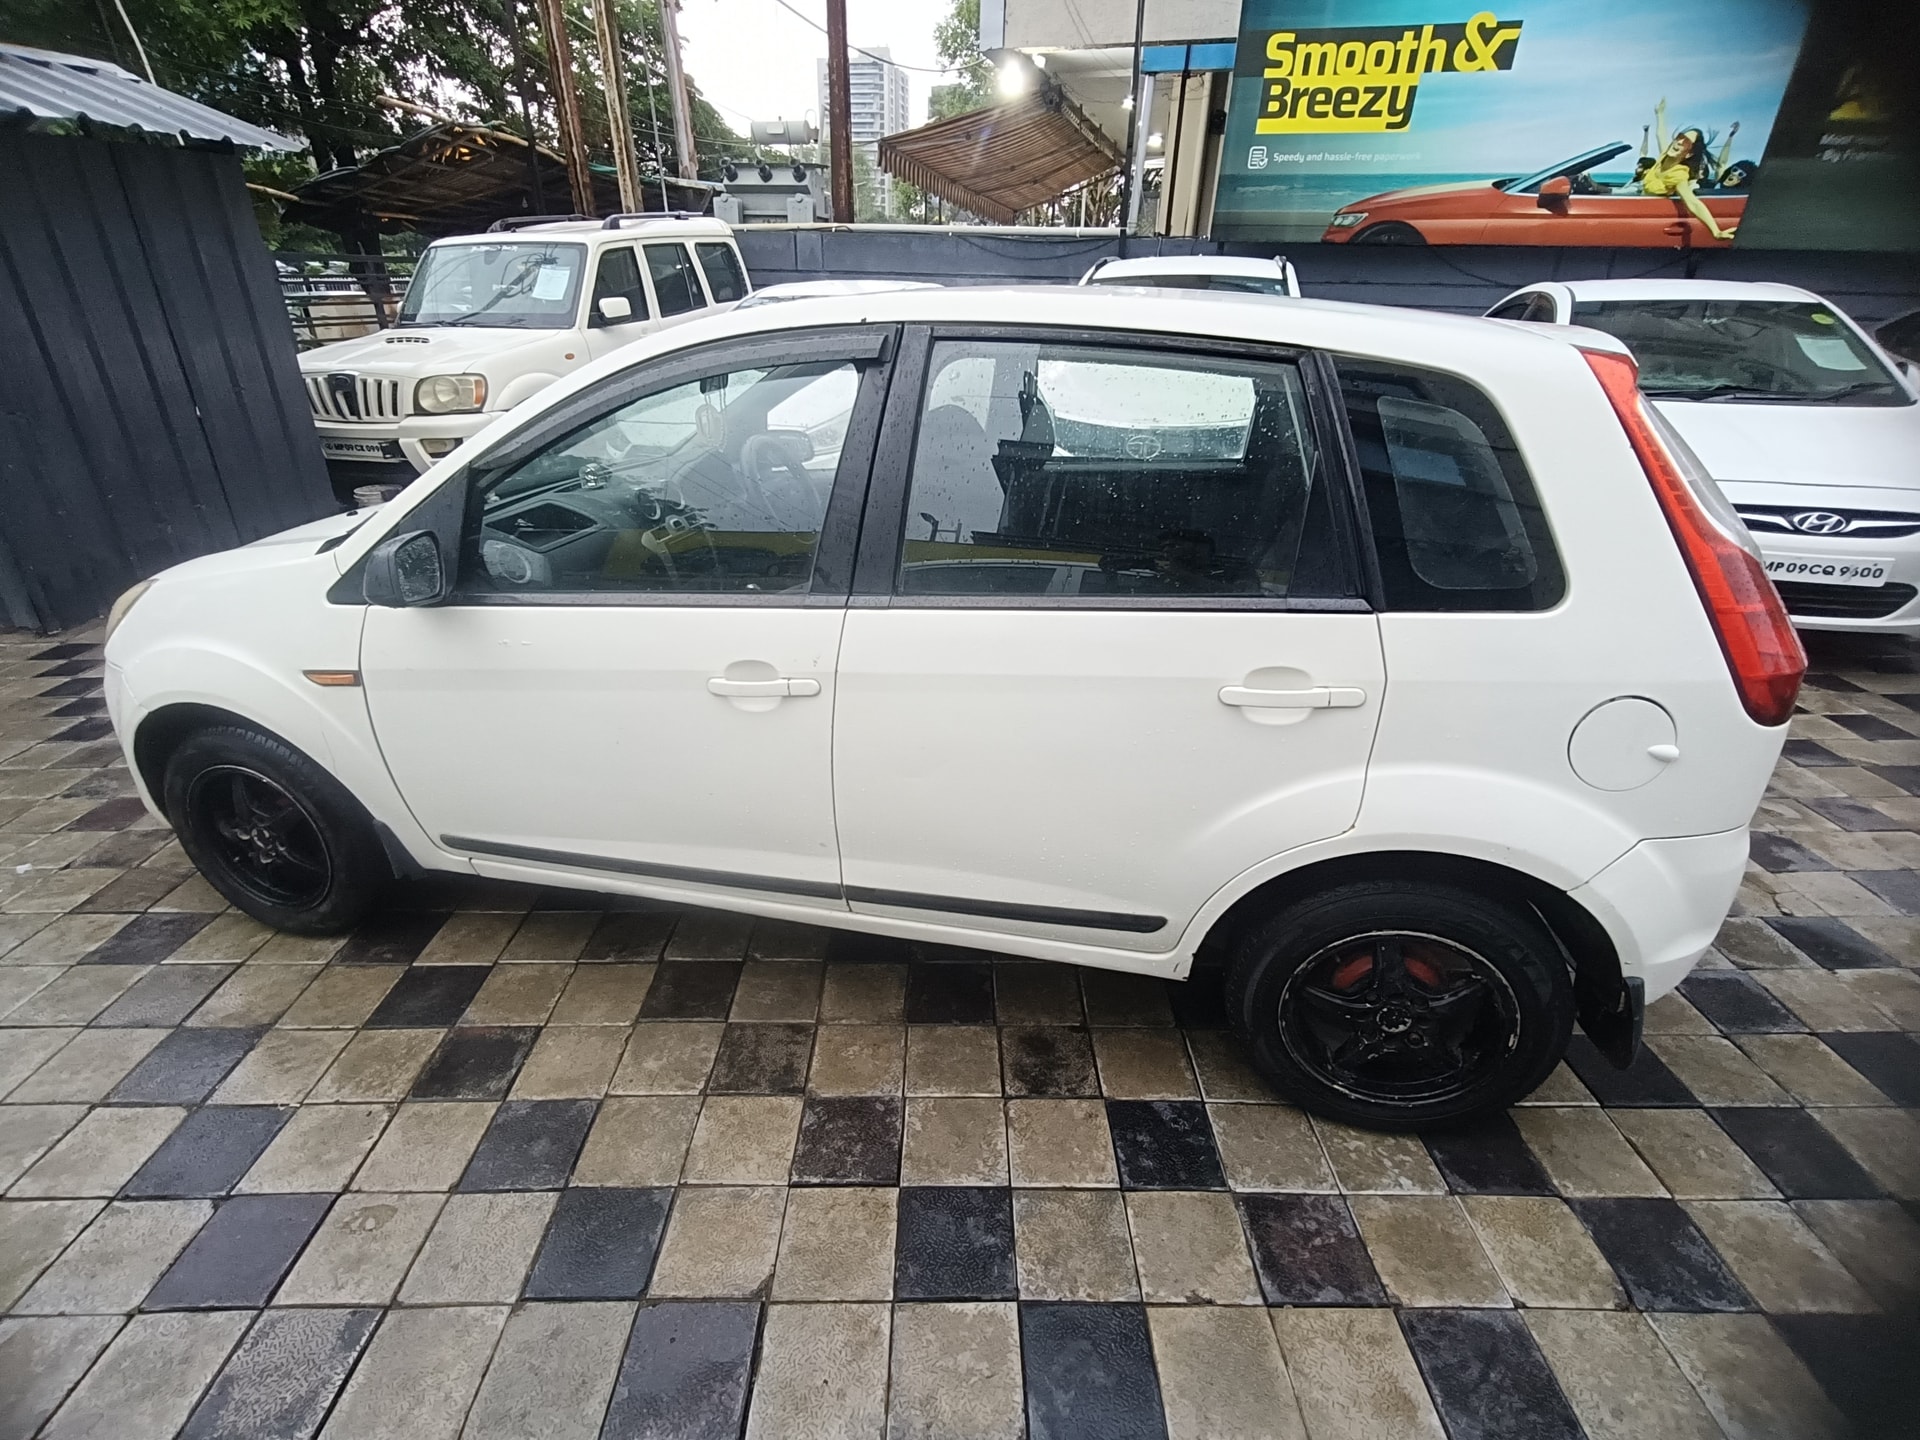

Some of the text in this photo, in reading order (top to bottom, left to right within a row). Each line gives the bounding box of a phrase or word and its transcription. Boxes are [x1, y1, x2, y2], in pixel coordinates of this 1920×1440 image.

[1264, 11, 1521, 77] Smooth &
[1258, 77, 1418, 130] Breezy
[1273, 152, 1304, 163] Speedy
[1306, 152, 1323, 161] and
[1324, 151, 1372, 161] hassle-free
